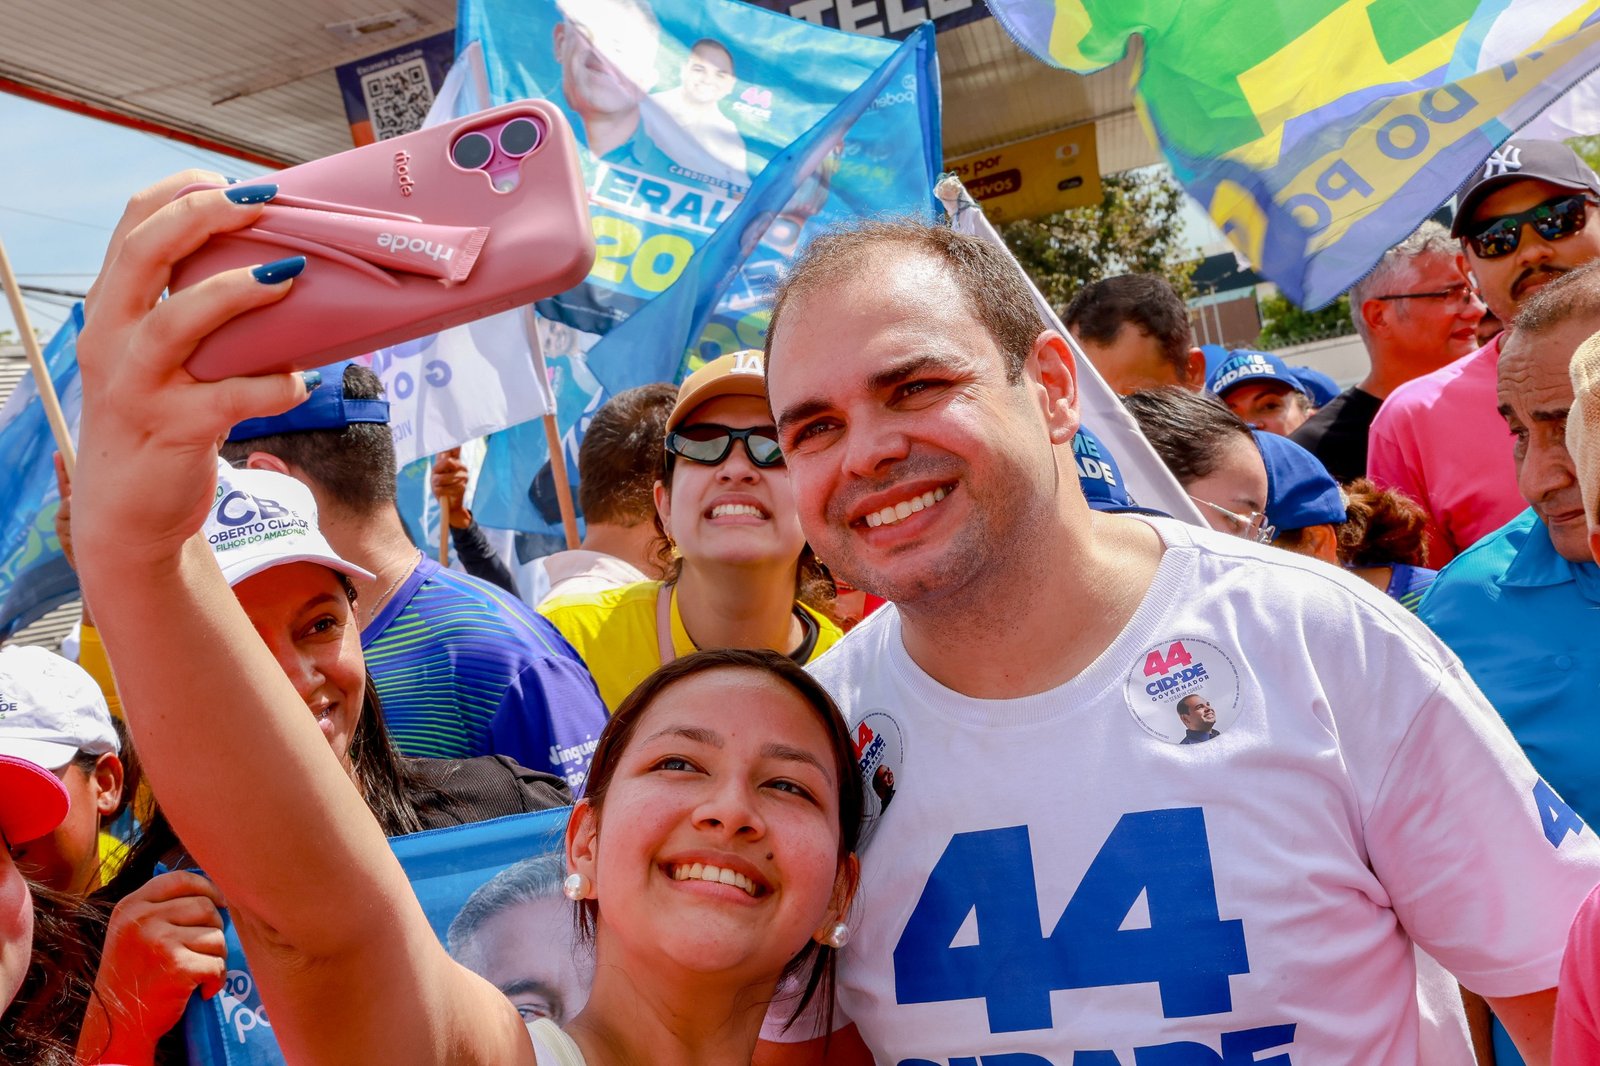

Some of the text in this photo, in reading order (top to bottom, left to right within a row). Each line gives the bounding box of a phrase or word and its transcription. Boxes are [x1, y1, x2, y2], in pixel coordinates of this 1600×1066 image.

[396, 150, 415, 197] rhode
[669, 165, 730, 190] CANDIDATO
[973, 155, 1002, 176] por
[377, 232, 455, 262] rhode
[730, 350, 766, 377] LA
[1213, 363, 1276, 393] CIDADE
[217, 490, 290, 527] CB
[208, 522, 265, 545] OBERTO
[216, 527, 307, 553] FILHOS DO AMAZONAS
[1143, 640, 1192, 677] 44
[1145, 662, 1207, 696] CIDADE
[1151, 674, 1210, 702] GOVERNADOR
[893, 806, 1251, 1034] 44
[226, 975, 249, 997] 20
